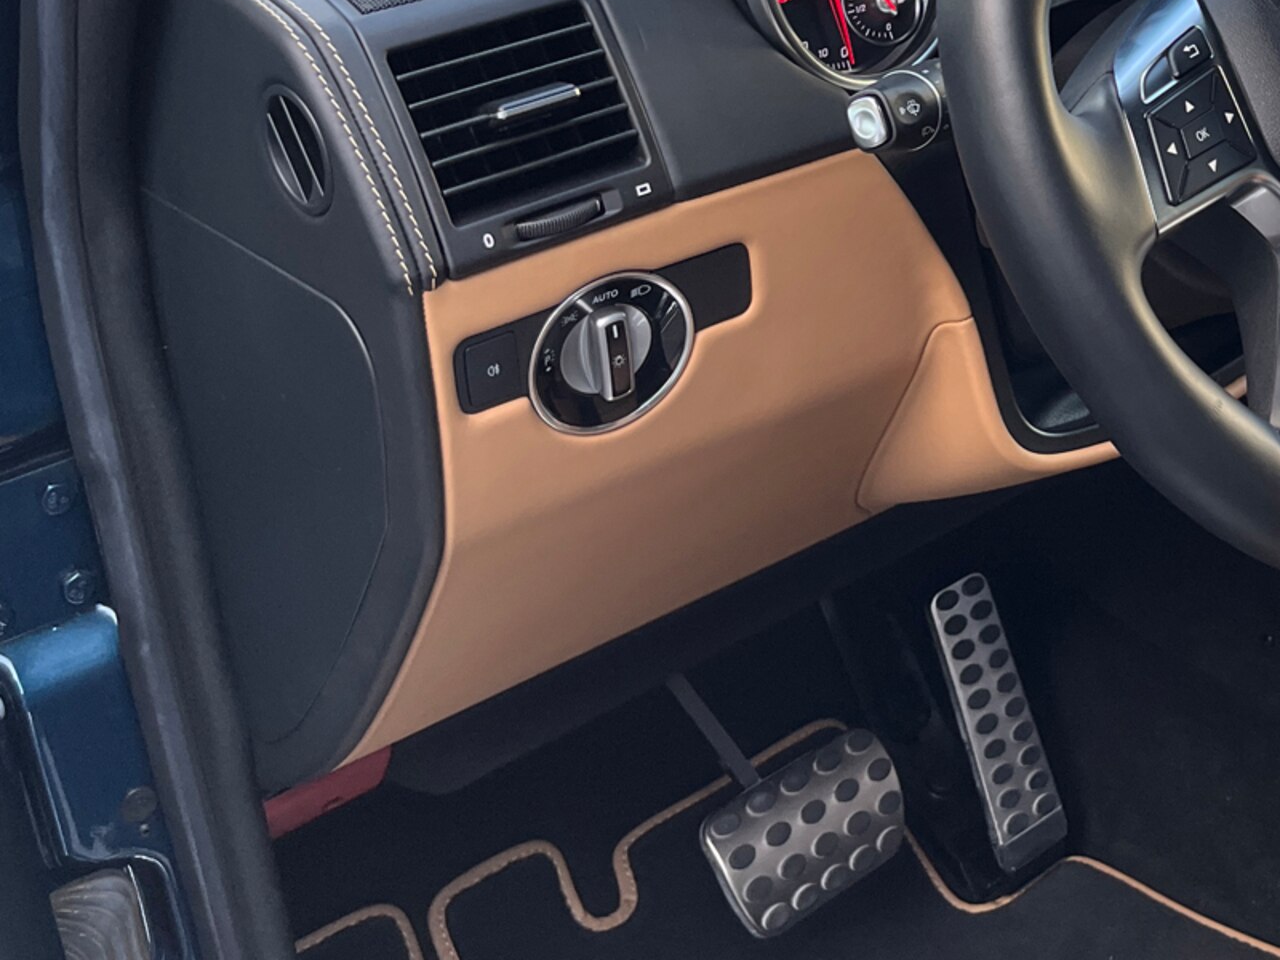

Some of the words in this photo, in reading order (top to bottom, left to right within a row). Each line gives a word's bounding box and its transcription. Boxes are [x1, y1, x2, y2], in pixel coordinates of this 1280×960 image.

[817, 47, 829, 59] 10
[839, 45, 849, 59] 0
[1195, 126, 1210, 142] OK
[591, 288, 619, 305] AUTO
